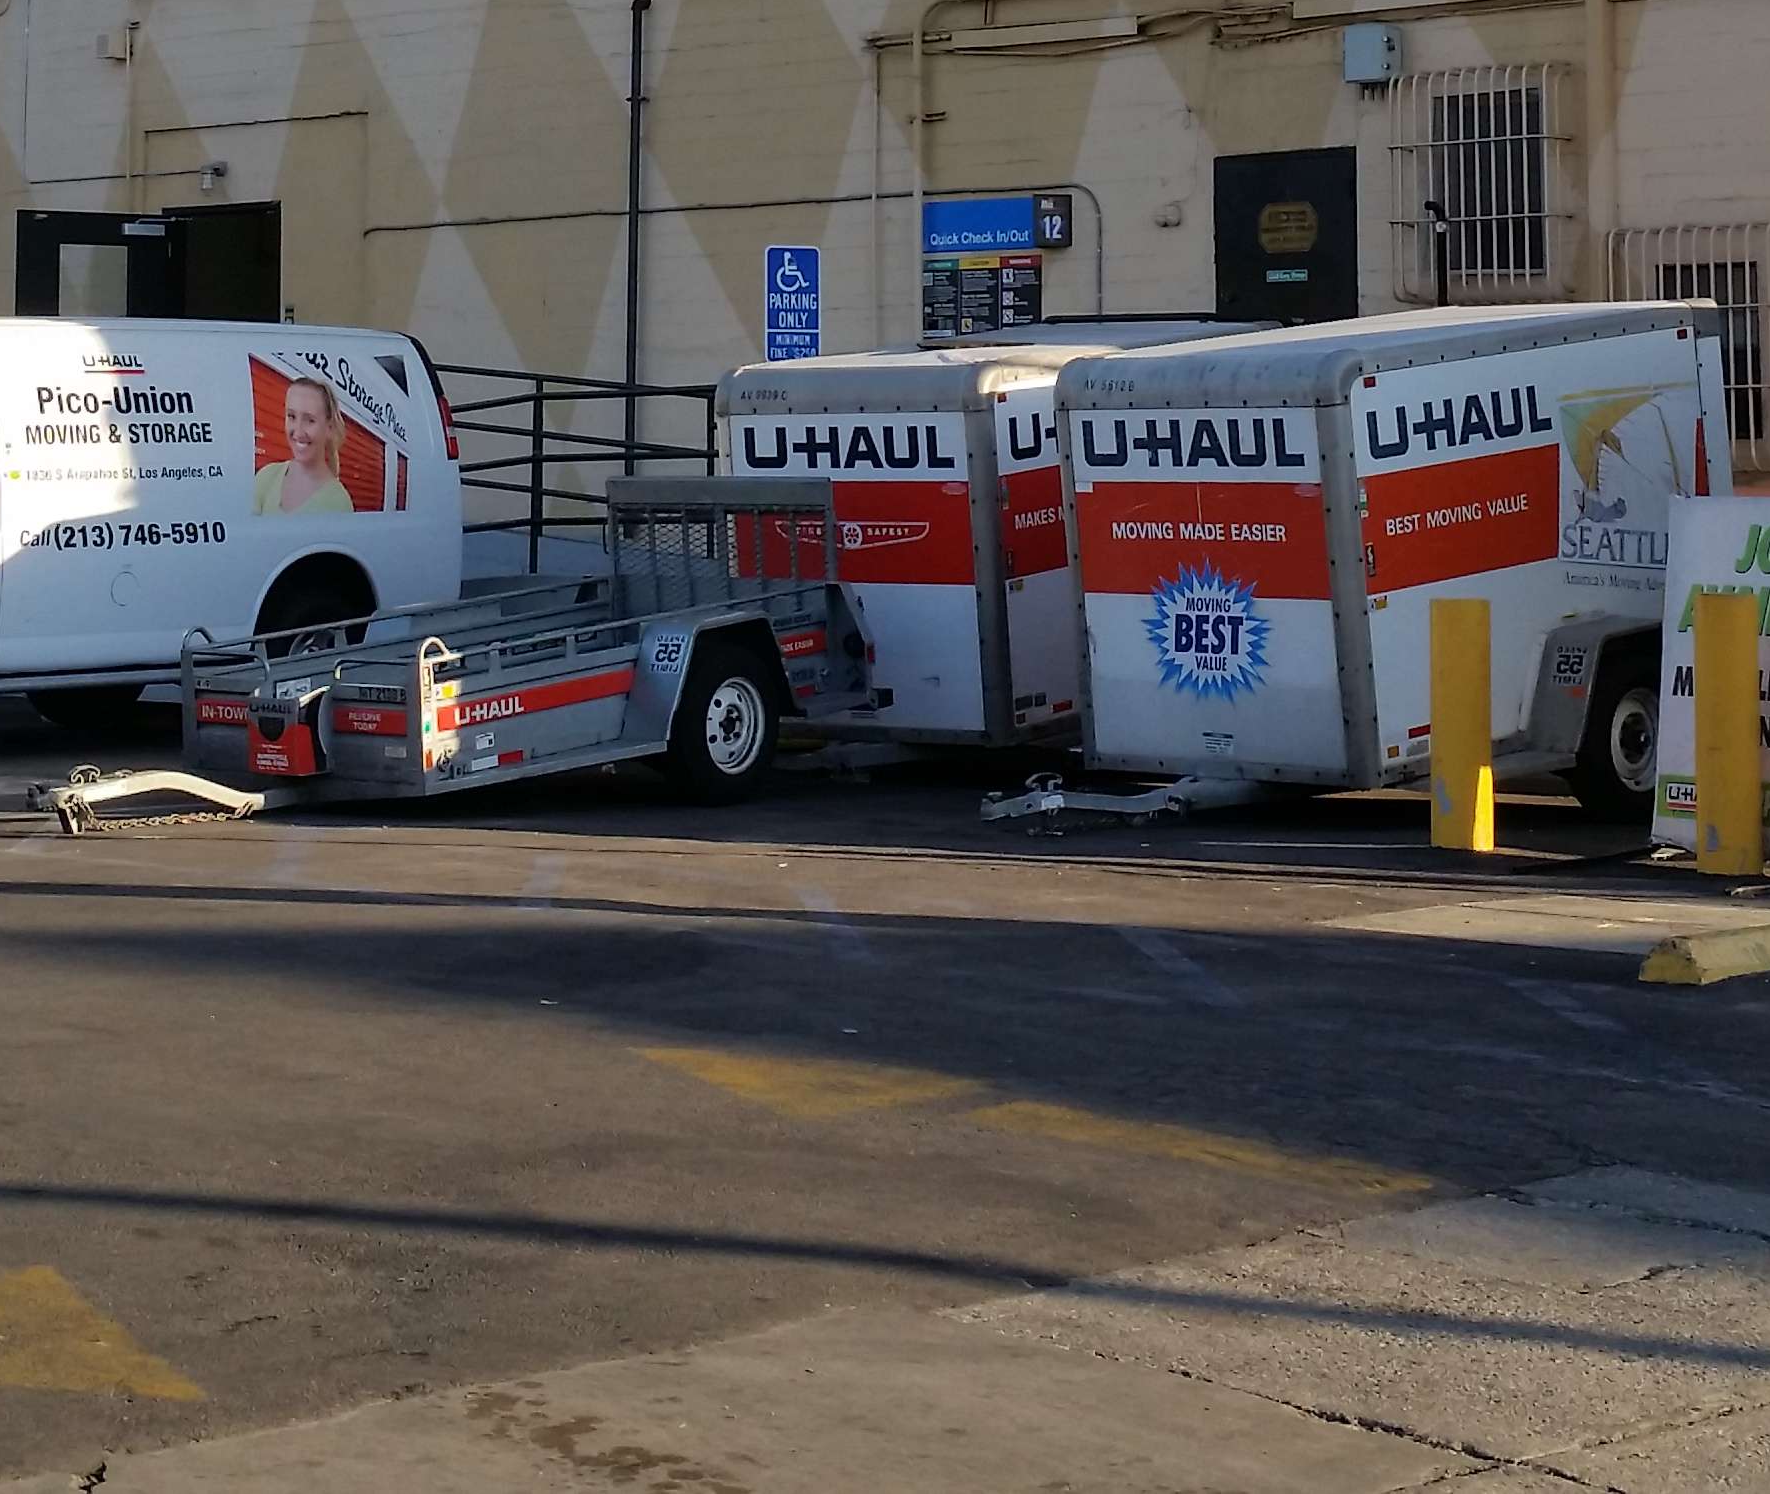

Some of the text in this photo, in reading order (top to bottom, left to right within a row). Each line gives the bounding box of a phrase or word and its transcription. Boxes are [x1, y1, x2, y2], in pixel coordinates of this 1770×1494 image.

[930, 229, 1030, 246] Quick Check In/Out
[1043, 215, 1062, 239] 12
[769, 293, 817, 310] PARKING
[778, 311, 808, 328] ONLY
[82, 354, 143, 367] U-HAUL
[36, 385, 195, 415] Pico-Union
[335, 357, 386, 425] Storage
[25, 422, 213, 445] MOVING & STORAGE
[1365, 385, 1554, 460] U-HAUL
[743, 424, 955, 469] U-HAUL
[1081, 417, 1306, 467] U-HAUL
[139, 467, 158, 479] Los
[160, 466, 207, 481] Angeles,
[208, 465, 224, 478] CA
[1014, 507, 1056, 530] MAKES
[1385, 494, 1529, 537] BEST MOVING VALUE
[20, 520, 226, 551] Call (213) 746-5910
[867, 527, 910, 536] SAFEST
[1112, 521, 1287, 543] MOVING MADE EASIER
[1561, 523, 1669, 566] SEATTL
[1185, 597, 1232, 613] MOVING
[1174, 613, 1244, 656] BEST
[1195, 655, 1229, 672] VALUE
[454, 696, 525, 725] U-HAUL
